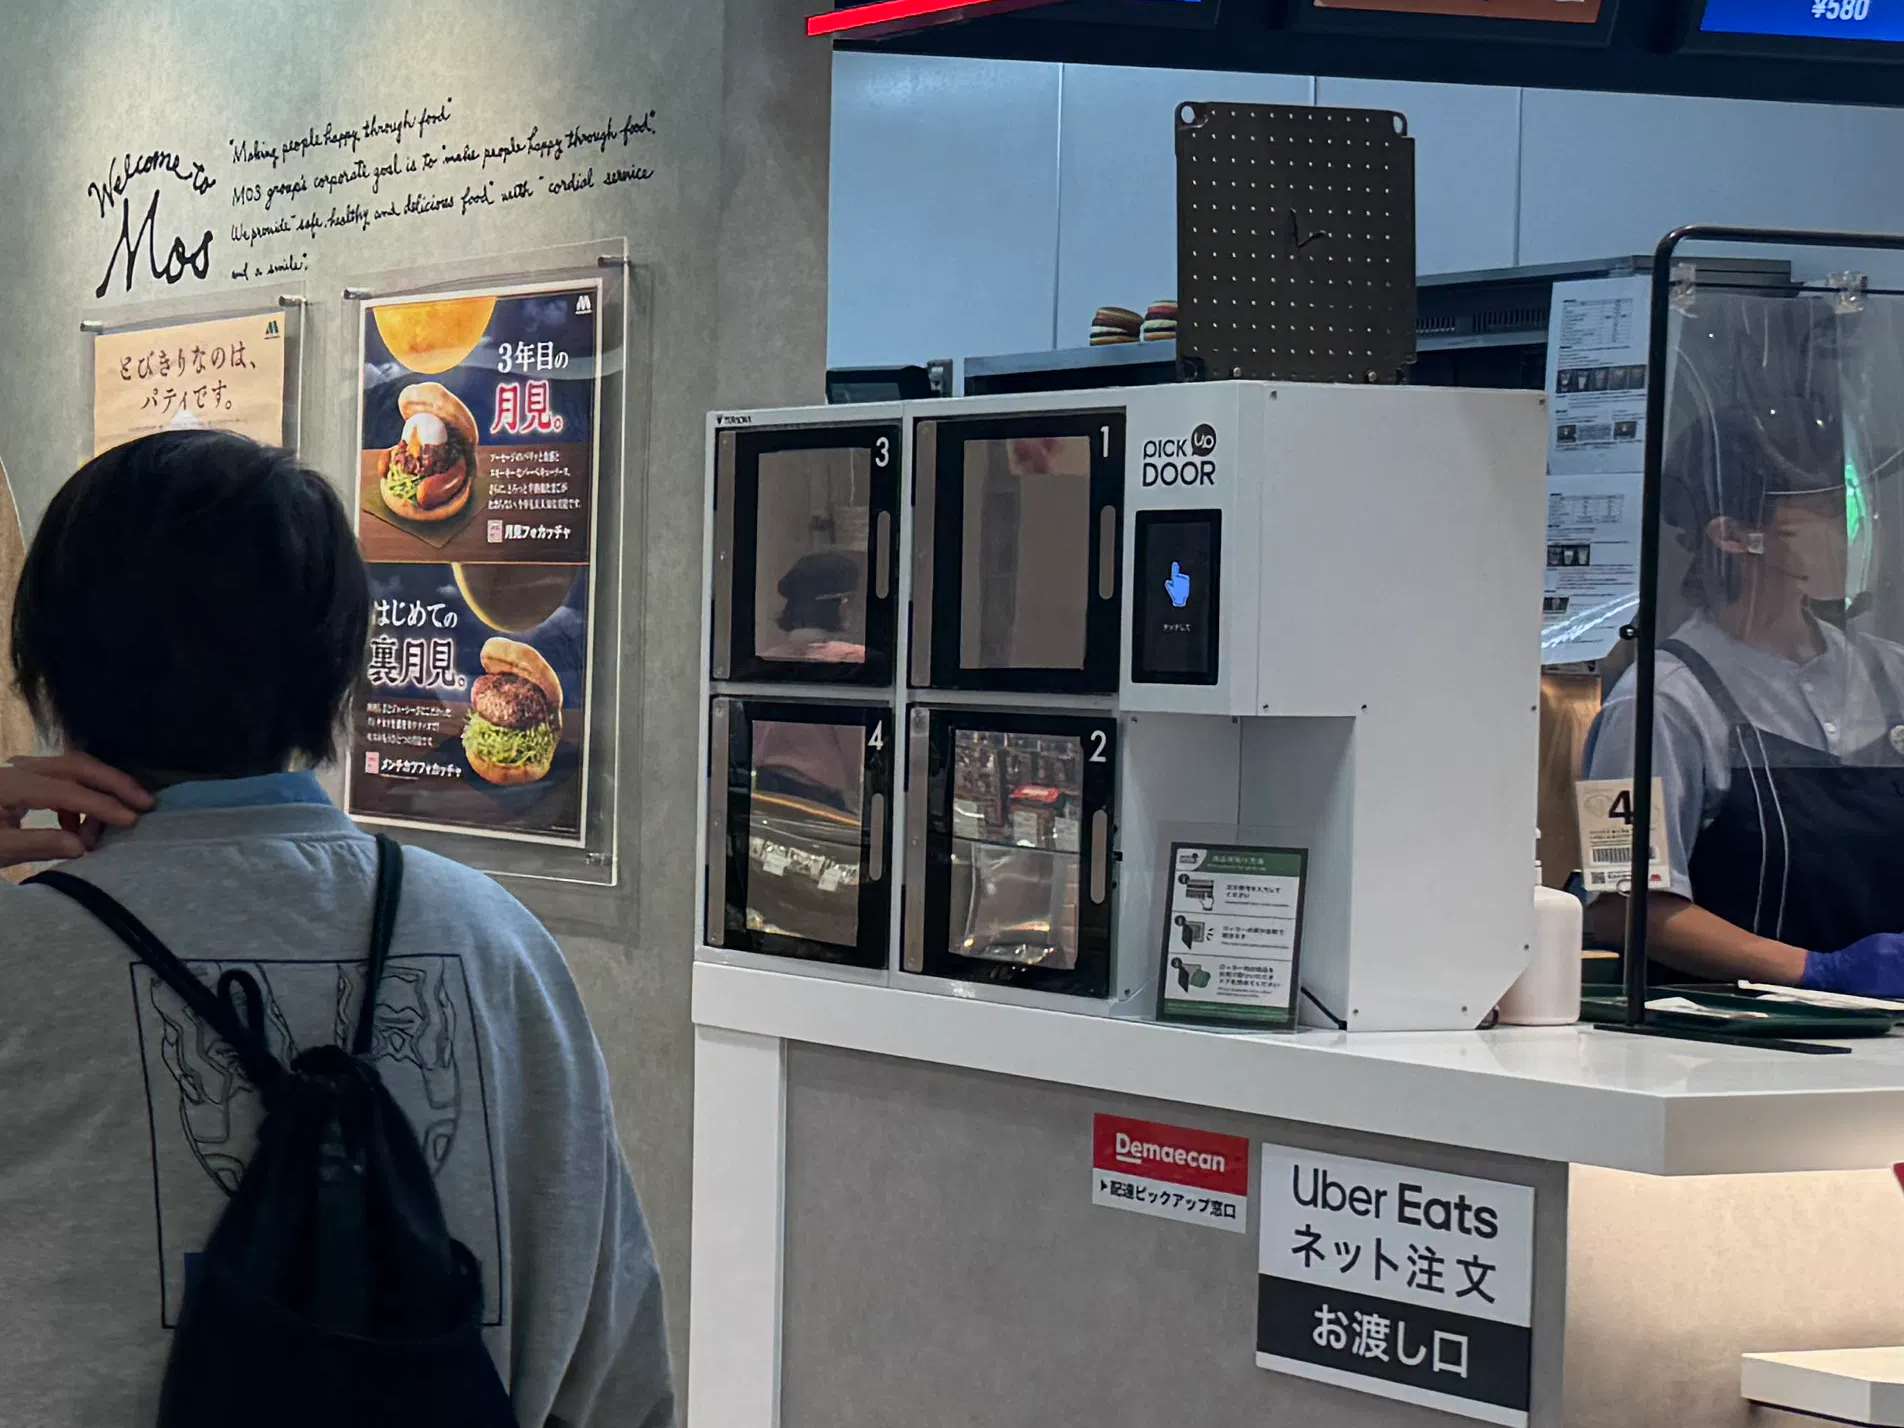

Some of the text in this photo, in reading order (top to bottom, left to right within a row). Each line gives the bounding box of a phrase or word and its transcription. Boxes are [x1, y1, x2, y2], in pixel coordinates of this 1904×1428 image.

[232, 186, 262, 206] MOS
[314, 160, 370, 195] corporate
[374, 154, 402, 193] goal
[406, 155, 417, 172] is
[422, 153, 438, 171] to
[482, 137, 527, 169] people
[527, 126, 563, 161] happy
[565, 117, 617, 152] through
[88, 150, 191, 218] Welcome
[373, 202, 401, 221] and
[96, 189, 214, 299] Mos
[119, 341, 257, 381] とびきりなのは、
[497, 340, 569, 373] 3年目の
[141, 380, 233, 414] パティです。
[490, 380, 564, 434] 月見。
[875, 436, 890, 468] 3
[1100, 425, 1110, 458] 1
[1143, 438, 1189, 460] PICK
[1142, 460, 1216, 487] DOOR
[374, 599, 458, 628] はじめての
[368, 633, 468, 691] 裏月見。
[867, 720, 885, 751] 4
[1089, 730, 1107, 763] 2
[1116, 1132, 1226, 1172] Demaecan
[1292, 1164, 1499, 1239] Uber Eats
[1291, 1223, 1497, 1304] ネット注文
[1312, 1302, 1469, 1379] お渡し口
